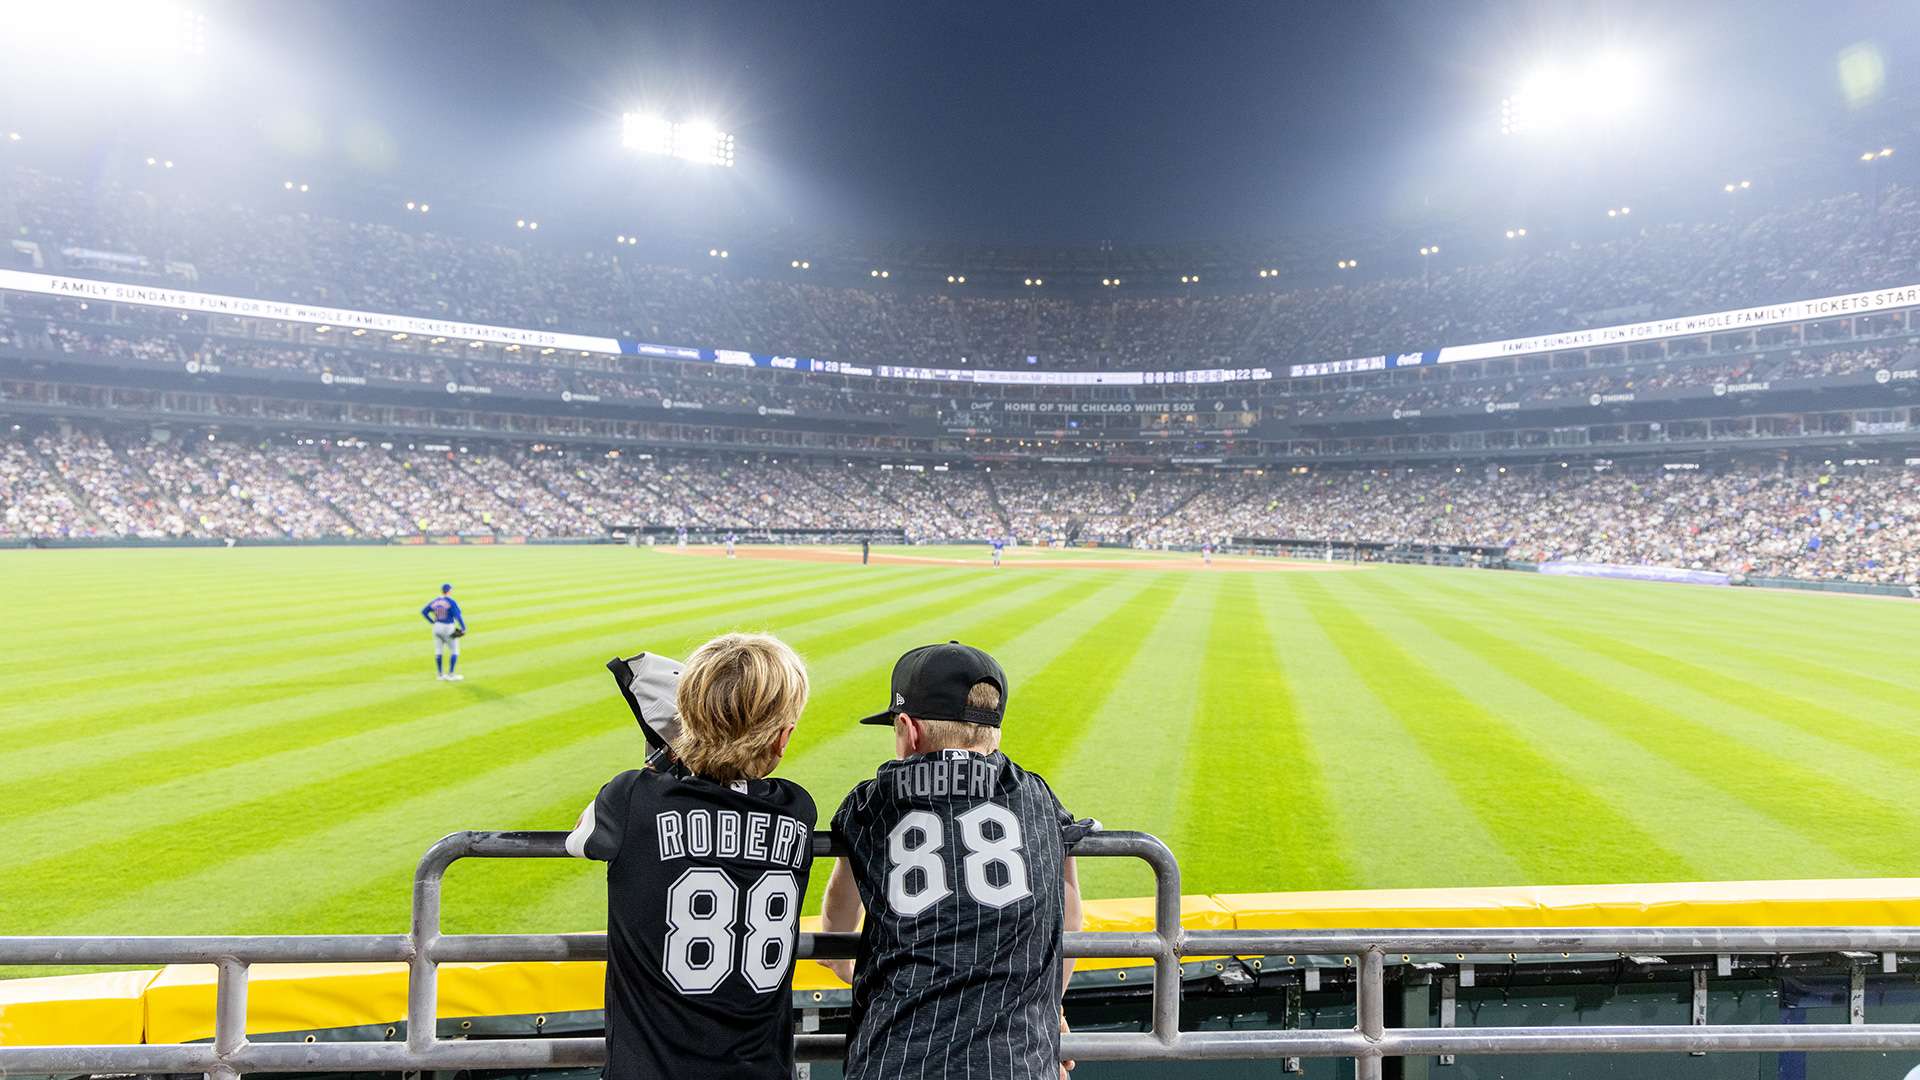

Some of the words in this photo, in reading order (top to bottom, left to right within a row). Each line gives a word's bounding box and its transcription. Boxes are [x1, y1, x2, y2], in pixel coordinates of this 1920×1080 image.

[51, 279, 110, 296] FAMILY
[116, 287, 186, 304] SUNDAYS
[200, 297, 227, 309] FUN
[233, 301, 260, 313] FOR
[266, 304, 290, 317] THE
[296, 308, 341, 322] WHOLE
[408, 320, 457, 334] TICKETS
[462, 327, 516, 341] STARTING
[521, 333, 533, 342] AT
[1503, 339, 1538, 352] FAMILY
[1543, 333, 1594, 348] SUNDAYS
[1603, 329, 1626, 340] FUN
[1630, 325, 1653, 337] FOR
[1657, 321, 1681, 333] THE
[1686, 313, 1732, 330] WHOLE
[1737, 307, 1792, 324] FAMILY!
[1805, 296, 1869, 315] TICKETS
[1236, 369, 1251, 380] 22
[1892, 369, 1919, 380] FISK
[458, 384, 492, 394] APPLING
[1727, 381, 1770, 394] BUEHRLE
[1602, 392, 1635, 403] THOMAS
[1004, 403, 1036, 412] HOME
[1039, 403, 1054, 412] OF
[1058, 403, 1078, 412] THE
[1081, 403, 1132, 412] CHICAGO
[1134, 403, 1170, 412] WHITE
[1173, 403, 1195, 412] SOX
[1402, 408, 1421, 417] LYONS
[896, 759, 998, 800] ROBERT
[656, 809, 808, 869] ROBERT
[886, 801, 1033, 917] 88
[661, 867, 800, 995] 88
